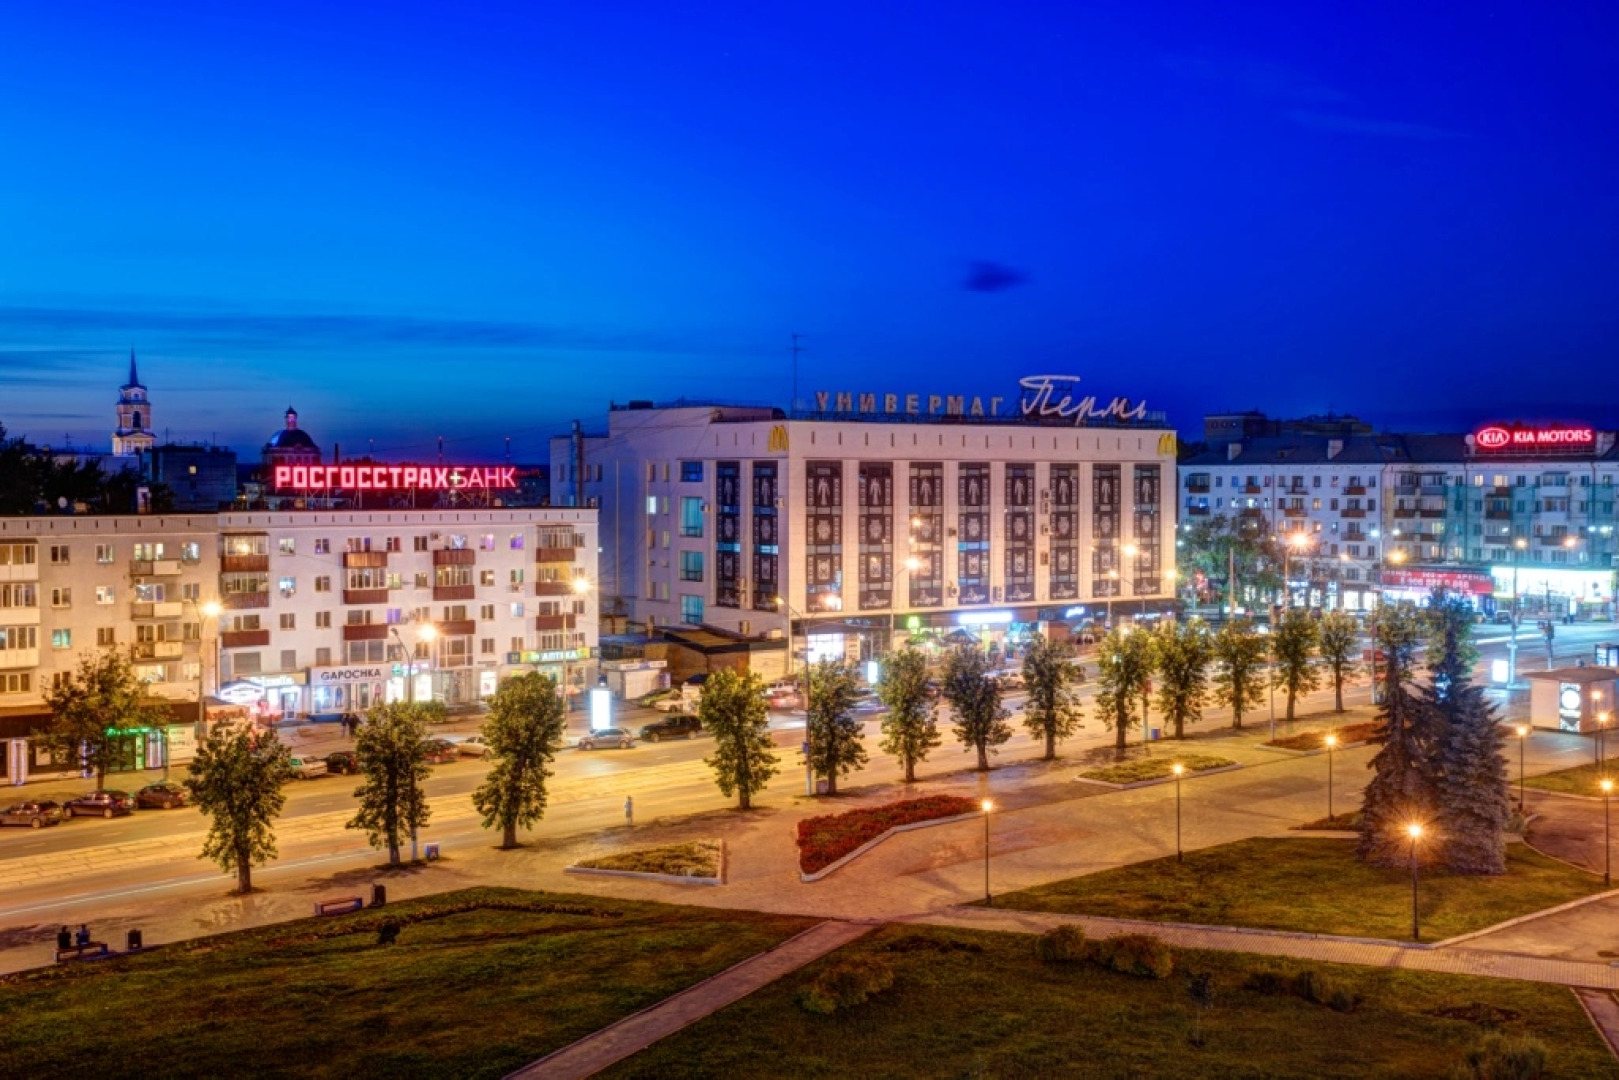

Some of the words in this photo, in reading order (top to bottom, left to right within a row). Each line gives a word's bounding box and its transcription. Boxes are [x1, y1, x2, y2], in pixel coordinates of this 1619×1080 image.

[816, 391, 1003, 416] УНИВЕРМАГ
[1019, 375, 1147, 426] Пермь
[1513, 431, 1534, 442] KIA
[1537, 429, 1592, 442] MOTORS
